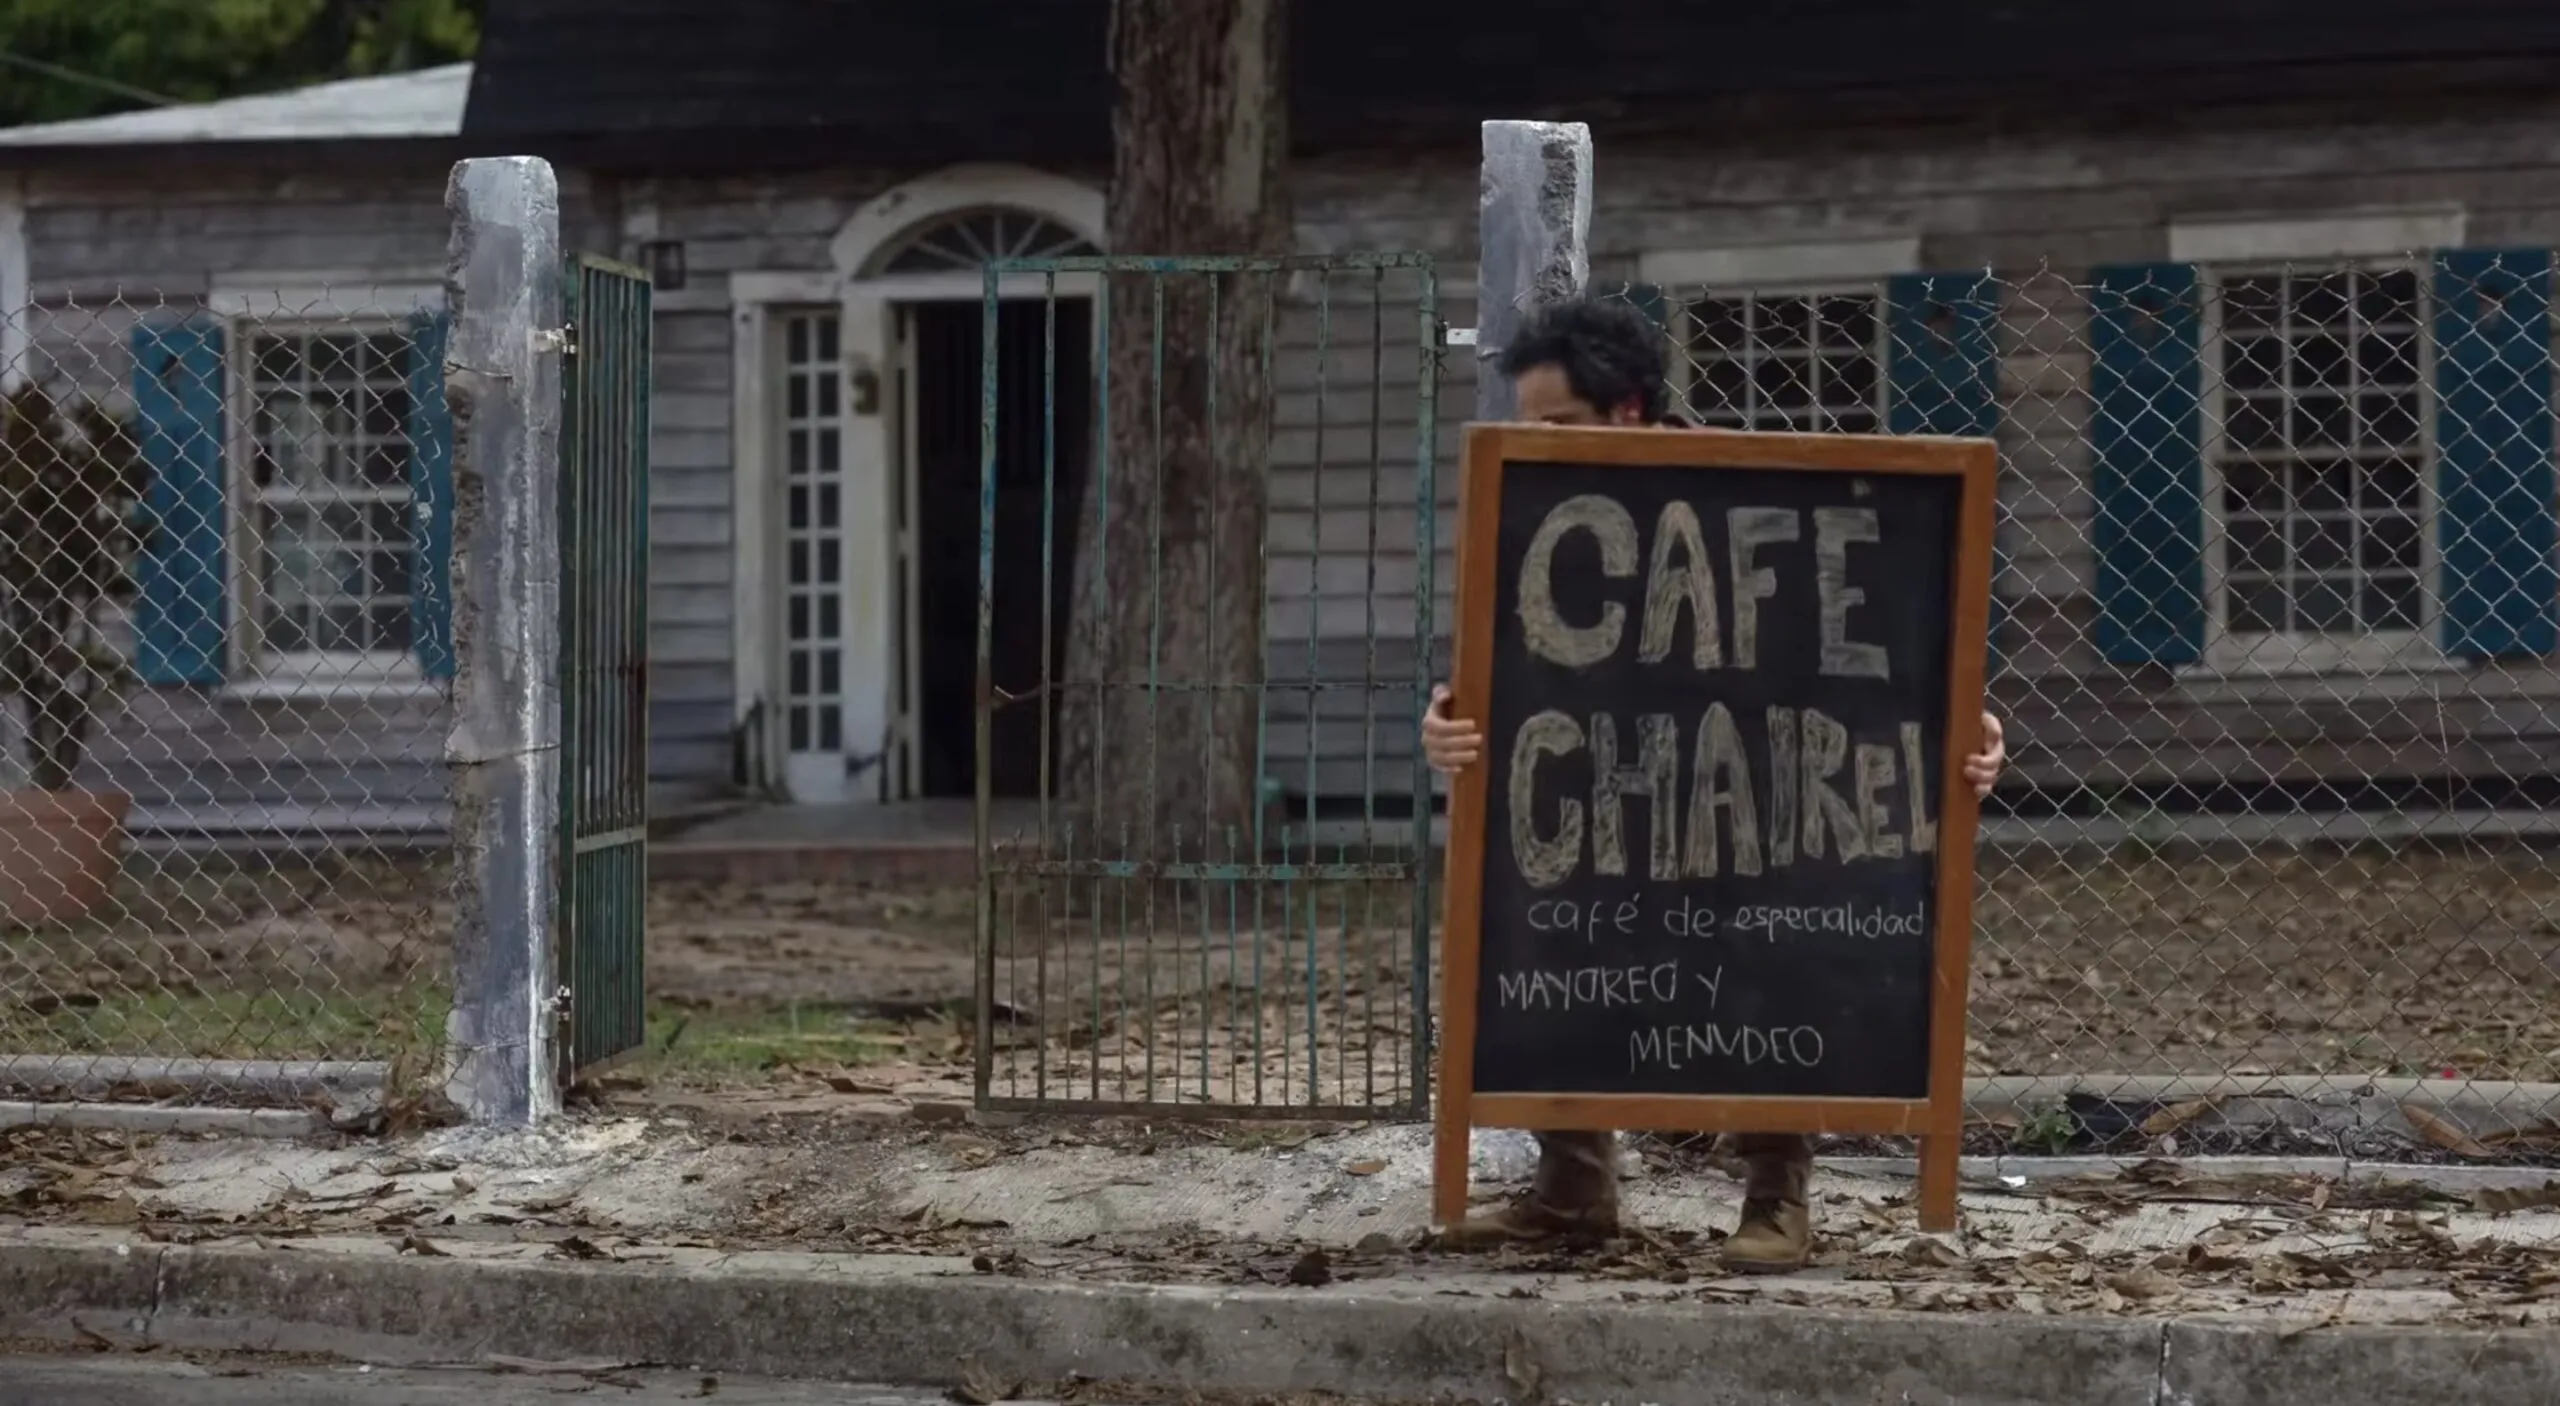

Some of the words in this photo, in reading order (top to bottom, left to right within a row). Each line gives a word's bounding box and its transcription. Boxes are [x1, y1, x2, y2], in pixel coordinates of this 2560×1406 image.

[1517, 477, 1890, 682] CAFÉ
[1527, 893, 1640, 943] café
[1664, 896, 1716, 938] de
[1733, 901, 1925, 943] especialidad
[1497, 959, 1678, 1010] MAYOREO
[1696, 965, 1722, 1009] Y
